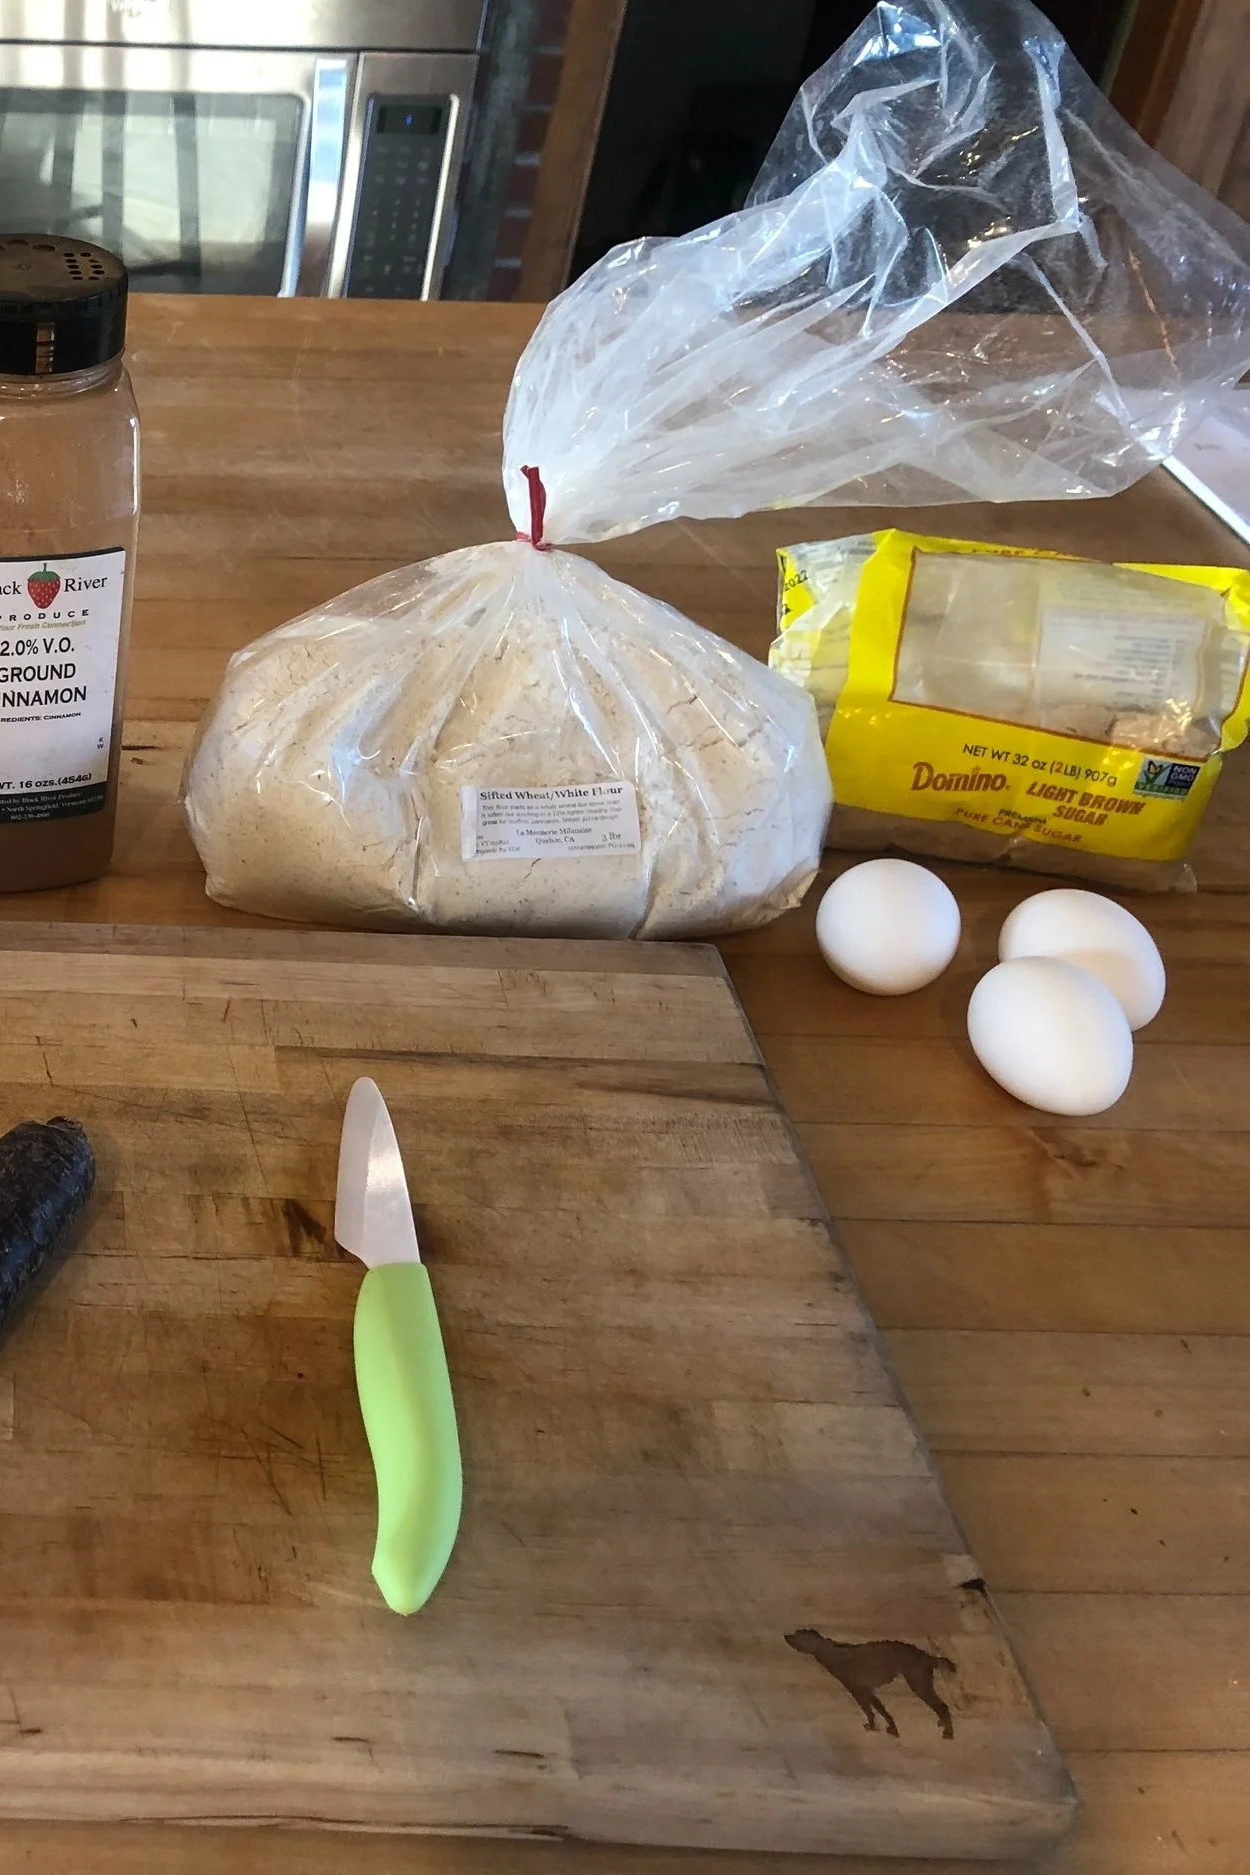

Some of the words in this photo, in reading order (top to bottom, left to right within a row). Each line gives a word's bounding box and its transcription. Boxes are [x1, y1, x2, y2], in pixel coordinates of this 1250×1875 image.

[64, 576, 108, 592] River
[784, 570, 809, 591] 2022
[16, 621, 40, 630] Fresh
[41, 619, 86, 629] Connection
[0, 639, 38, 657] 2.0%
[42, 637, 75, 654] V.O.
[44, 712, 81, 720] CINNAMON
[962, 744, 988, 758] NET
[991, 749, 1011, 762] WT
[1012, 753, 1028, 766] 32
[1032, 759, 1047, 770] oz
[1084, 770, 1117, 787] 907g
[1173, 765, 1198, 775] NON
[19, 780, 32, 788] 16
[910, 761, 1006, 792] Domino
[480, 791, 512, 800] Sifted
[592, 787, 623, 796] Flour
[1026, 781, 1078, 804] LIGHT
[1078, 791, 1146, 816] BROWN
[955, 807, 990, 823] PURE
[1052, 805, 1108, 826] SUGAR
